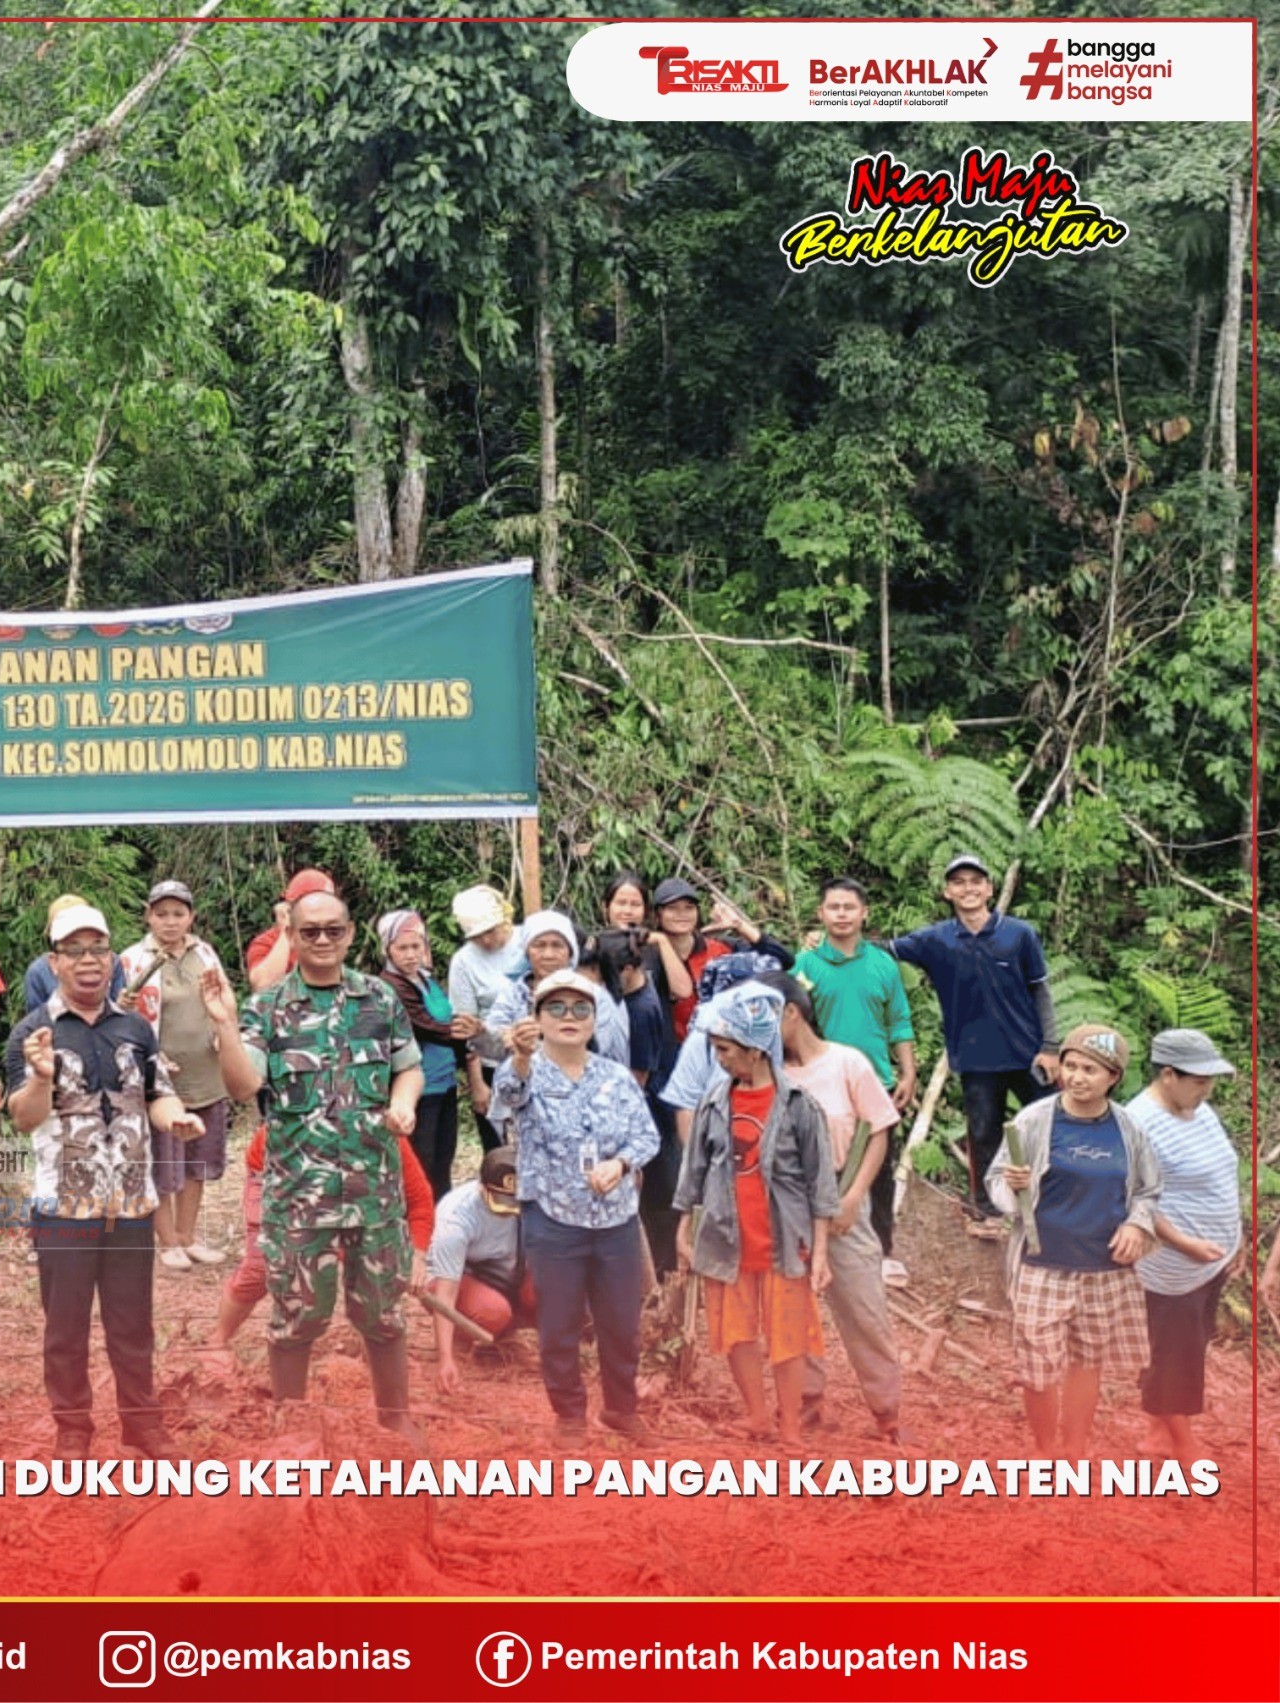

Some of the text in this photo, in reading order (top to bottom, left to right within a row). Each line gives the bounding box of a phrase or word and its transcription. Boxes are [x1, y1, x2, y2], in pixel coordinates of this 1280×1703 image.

[110, 643, 264, 681] PANGAN
[3, 693, 56, 729] 130
[65, 690, 186, 727] TA.2026
[195, 686, 295, 723] KODIM
[303, 682, 469, 719] 0213/NIAS
[3, 737, 259, 775] KEC.SOMOLOMOLO
[268, 734, 405, 768] KAB.NIAS
